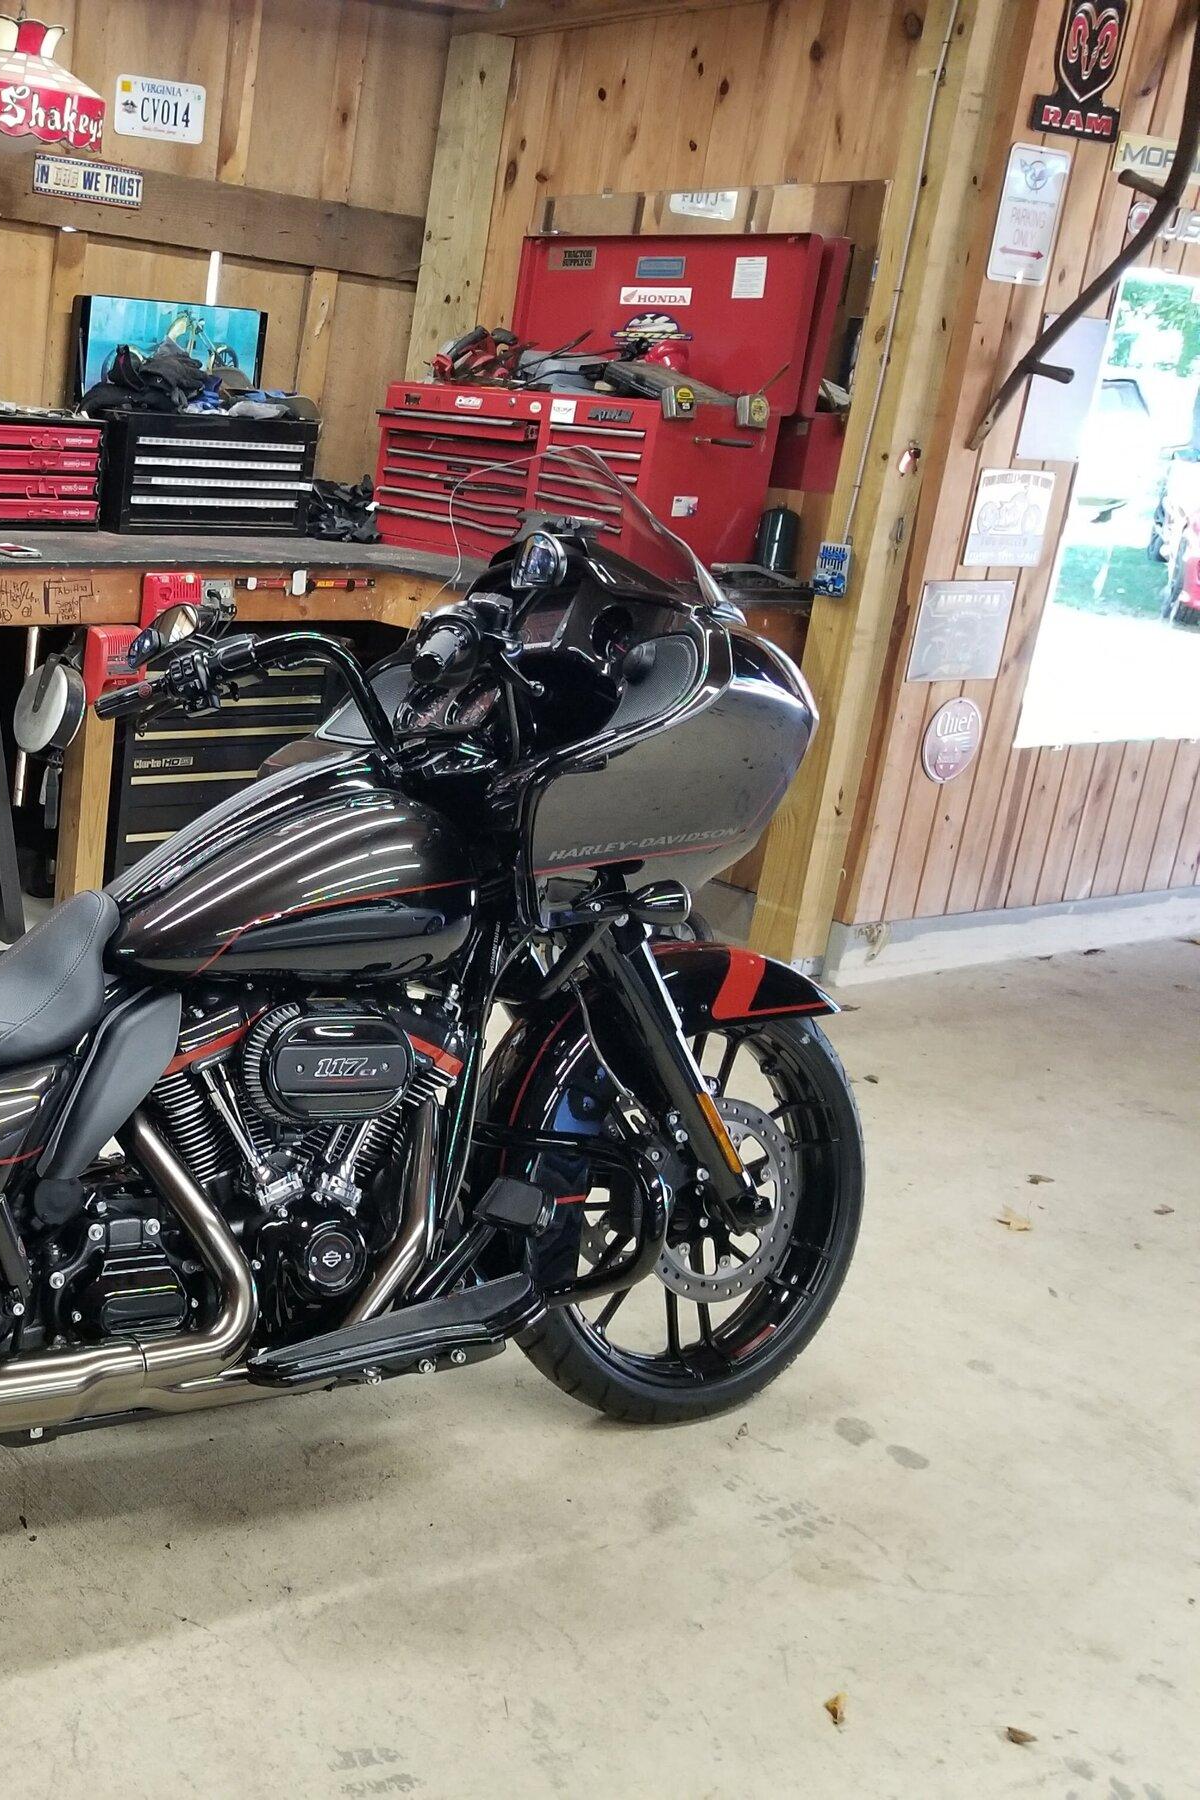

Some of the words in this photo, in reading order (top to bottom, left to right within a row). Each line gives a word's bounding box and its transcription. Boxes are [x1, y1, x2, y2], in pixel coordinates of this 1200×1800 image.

[141, 82, 182, 97] VIRGINIA
[1041, 104, 1113, 136] RAM
[35, 163, 50, 184] IN
[83, 171, 101, 192] WE
[105, 174, 142, 198] TRUST
[1010, 207, 1047, 230] PARKING
[1012, 229, 1037, 248] ONLY
[637, 294, 687, 304] HONDA
[936, 593, 1000, 608] AMERICAN
[936, 710, 976, 738] Chief
[133, 758, 161, 769] Clarke
[548, 826, 740, 862] HARLEY-DAVIDSON
[314, 1057, 368, 1077] 117
